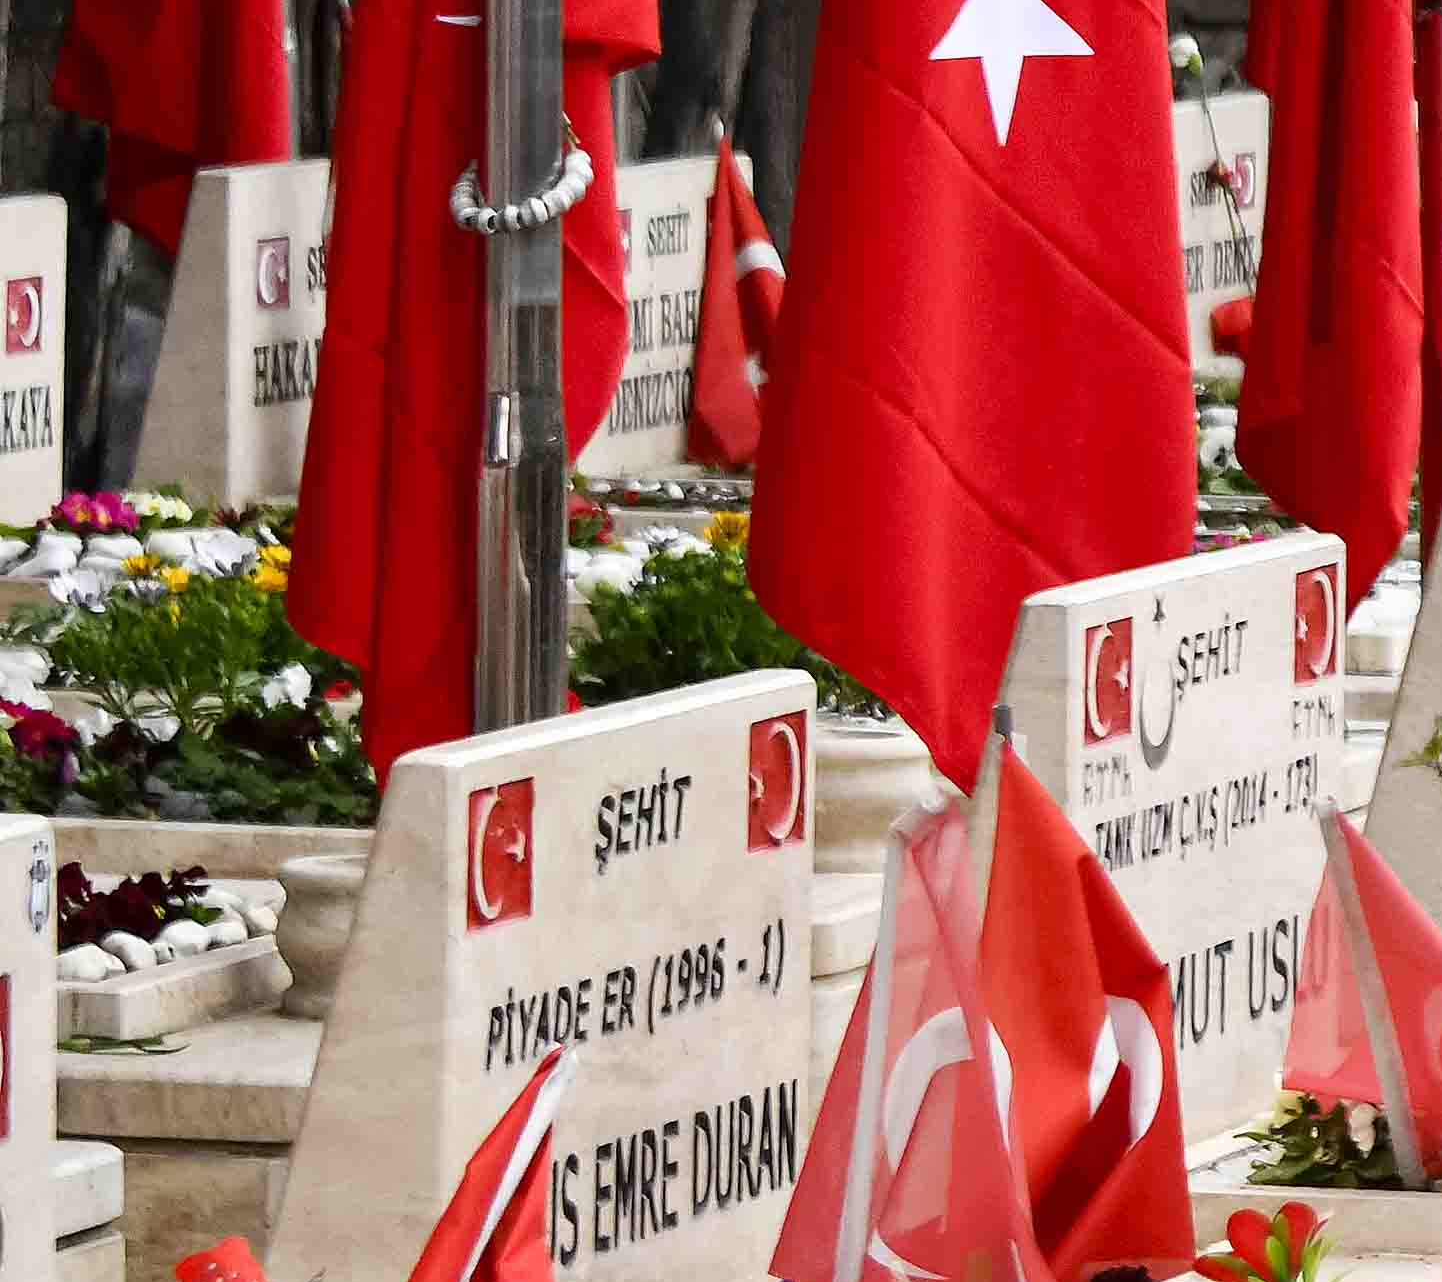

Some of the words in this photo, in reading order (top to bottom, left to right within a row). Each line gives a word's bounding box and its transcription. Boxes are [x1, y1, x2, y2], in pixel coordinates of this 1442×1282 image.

[1176, 612, 1249, 701] ŞEHİT
[594, 767, 692, 875] ŞEHİT
[485, 978, 592, 1071] PİYADE
[601, 965, 637, 1035] ER
[648, 937, 727, 1035] (1996
[758, 918, 786, 999] 1)
[594, 1120, 681, 1255] EMRE
[691, 1078, 799, 1217] DURAN
